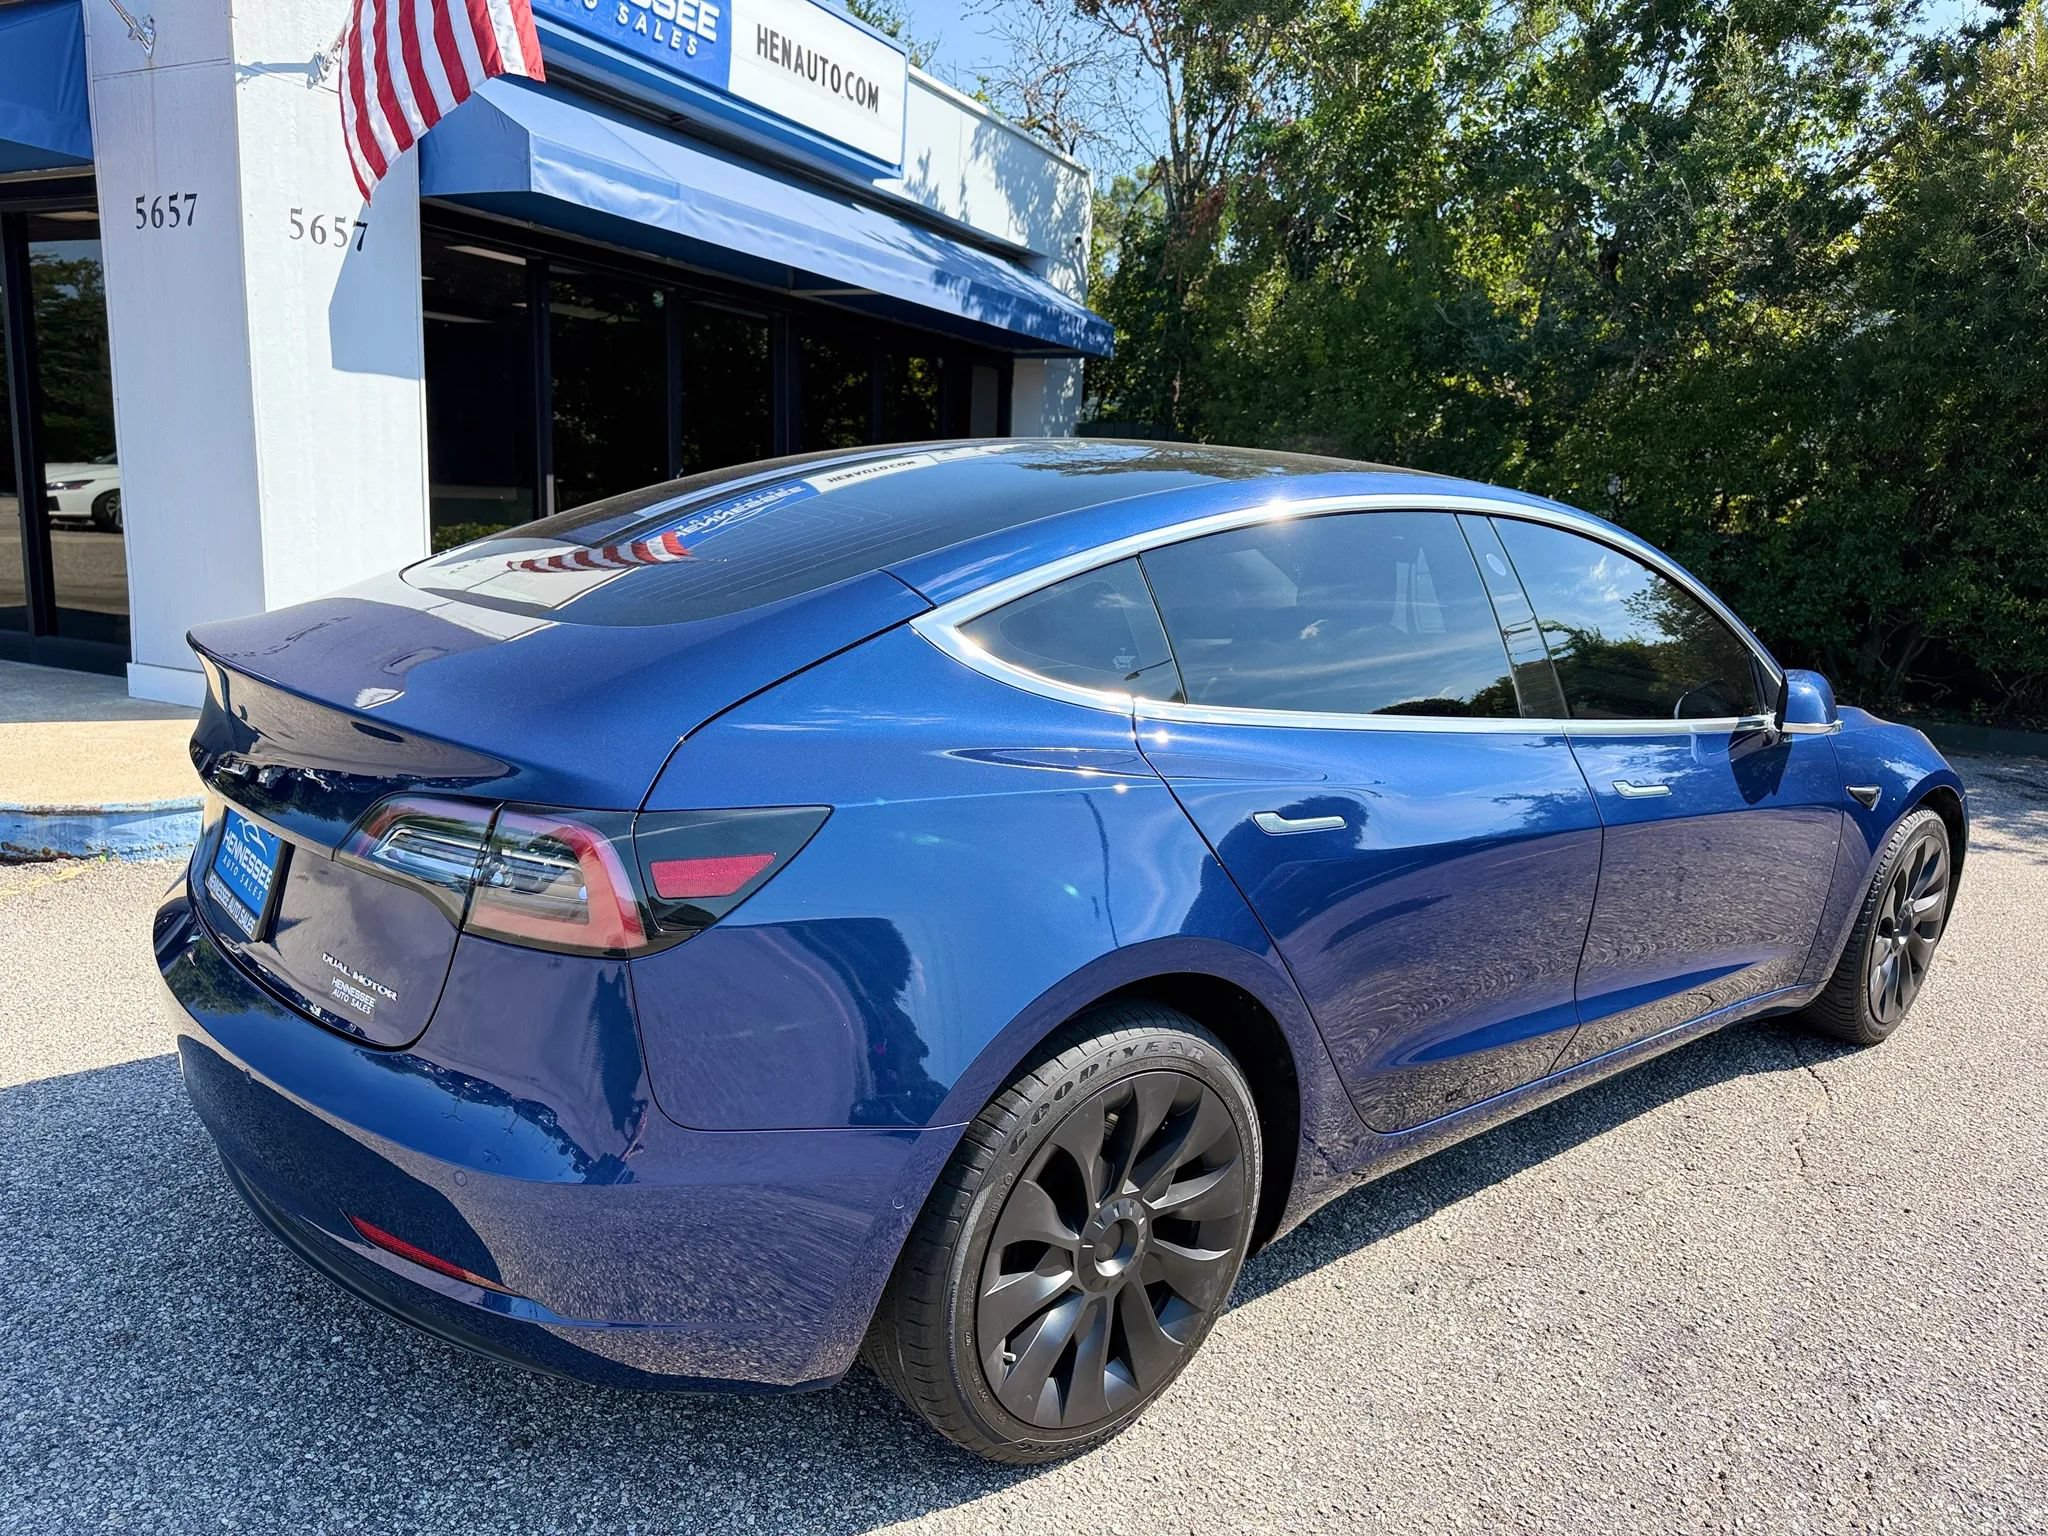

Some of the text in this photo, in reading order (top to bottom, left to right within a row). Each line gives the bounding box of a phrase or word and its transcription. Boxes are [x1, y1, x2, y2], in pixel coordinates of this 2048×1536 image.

[617, 4, 698, 56] SALES
[757, 23, 879, 113] HENAUTO.COM
[135, 192, 198, 230] 5657
[289, 207, 368, 252] 5657
[221, 827, 273, 891] HENNESSEE
[222, 854, 263, 901] AUTO SALES
[322, 952, 398, 1002] DUAL MOTOR
[331, 976, 376, 1008] HENNESSEE
[331, 988, 372, 1016] AUTO SALES
